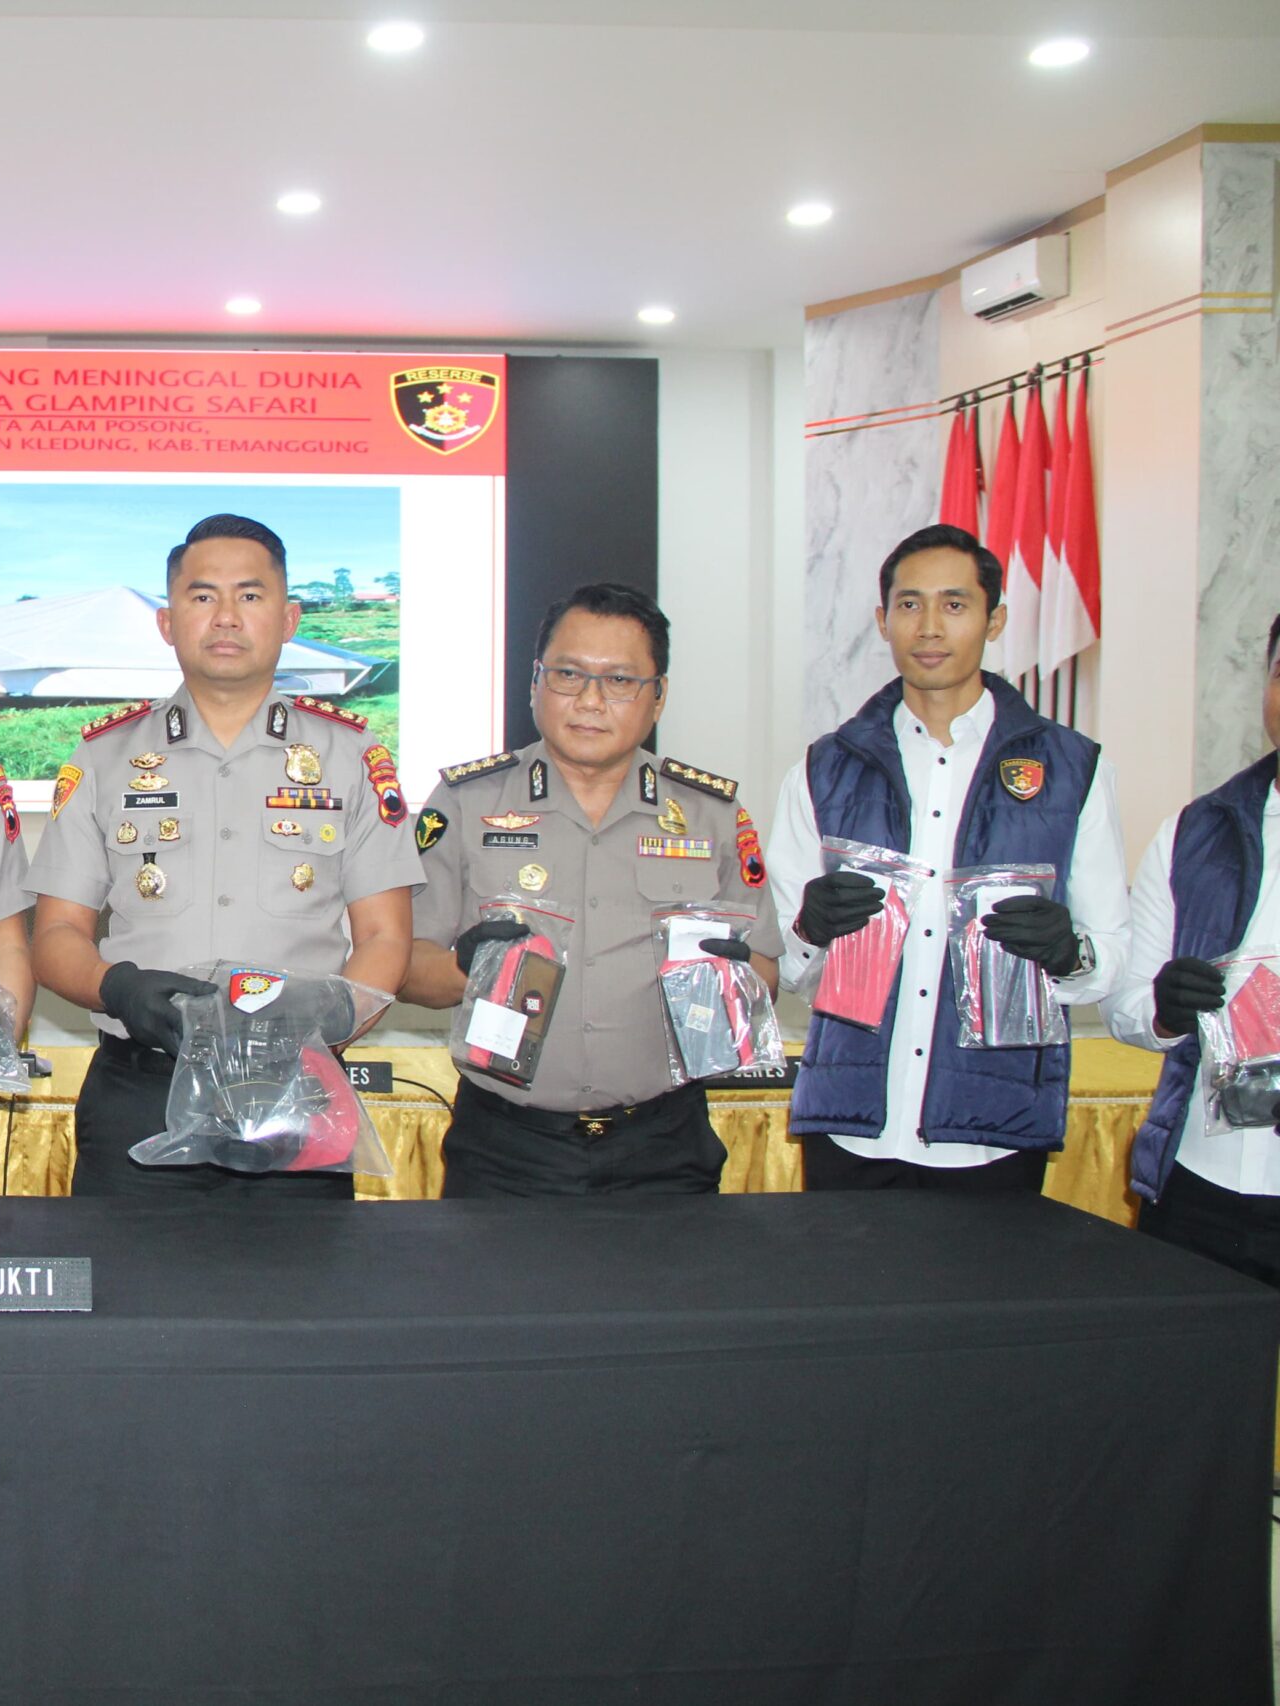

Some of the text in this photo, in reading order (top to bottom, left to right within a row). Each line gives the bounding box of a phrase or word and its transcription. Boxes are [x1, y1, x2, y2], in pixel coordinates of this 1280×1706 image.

[53, 369, 248, 388] MENINGGAL
[259, 371, 363, 389] DUNIA
[405, 368, 481, 382] RESERSE
[24, 394, 195, 413] GLAMPING
[207, 395, 318, 414] SAFARI
[29, 419, 96, 432] ALAM
[105, 420, 211, 434] POSONG,
[20, 437, 138, 452] KLEDUNG,
[147, 438, 370, 454] KAB.TEMANGGUNG
[135, 796, 166, 805] ZAMRUL
[346, 1066, 370, 1085] ES
